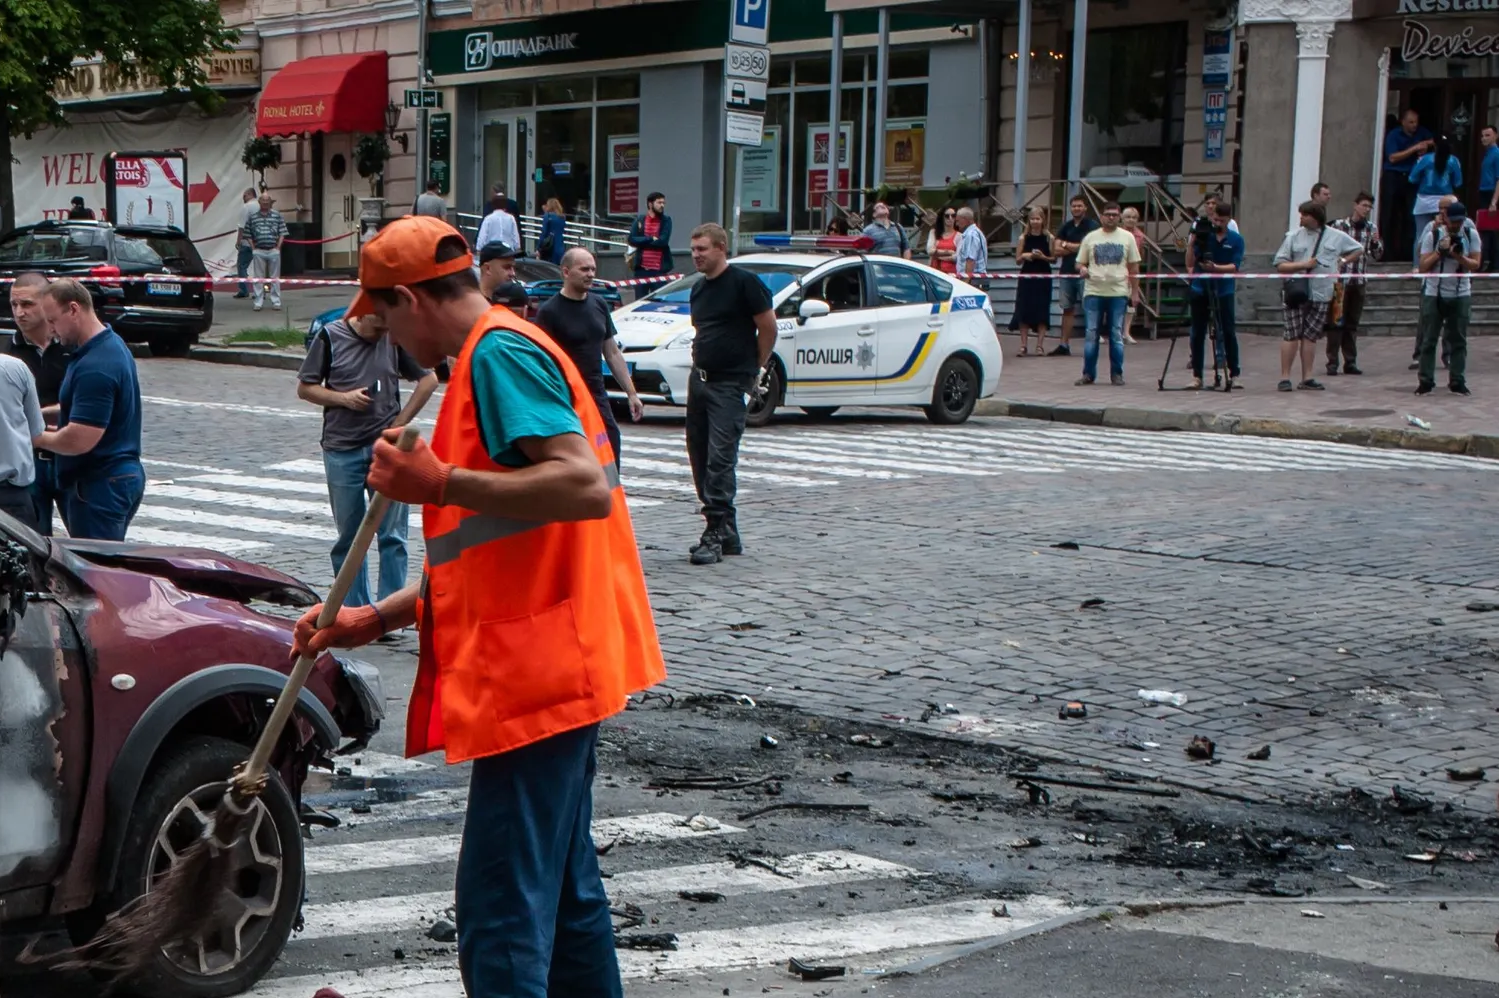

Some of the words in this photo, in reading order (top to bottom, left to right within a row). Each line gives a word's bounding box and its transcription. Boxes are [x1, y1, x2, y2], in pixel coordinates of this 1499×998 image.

[492, 33, 578, 58] ОЩАДБАНК
[210, 58, 254, 77] HOTEL
[263, 106, 287, 118] ROYAL
[290, 105, 314, 116] HOTEL
[115, 160, 140, 170] ELLA
[796, 349, 853, 364] ПОЛІЦІЯ
